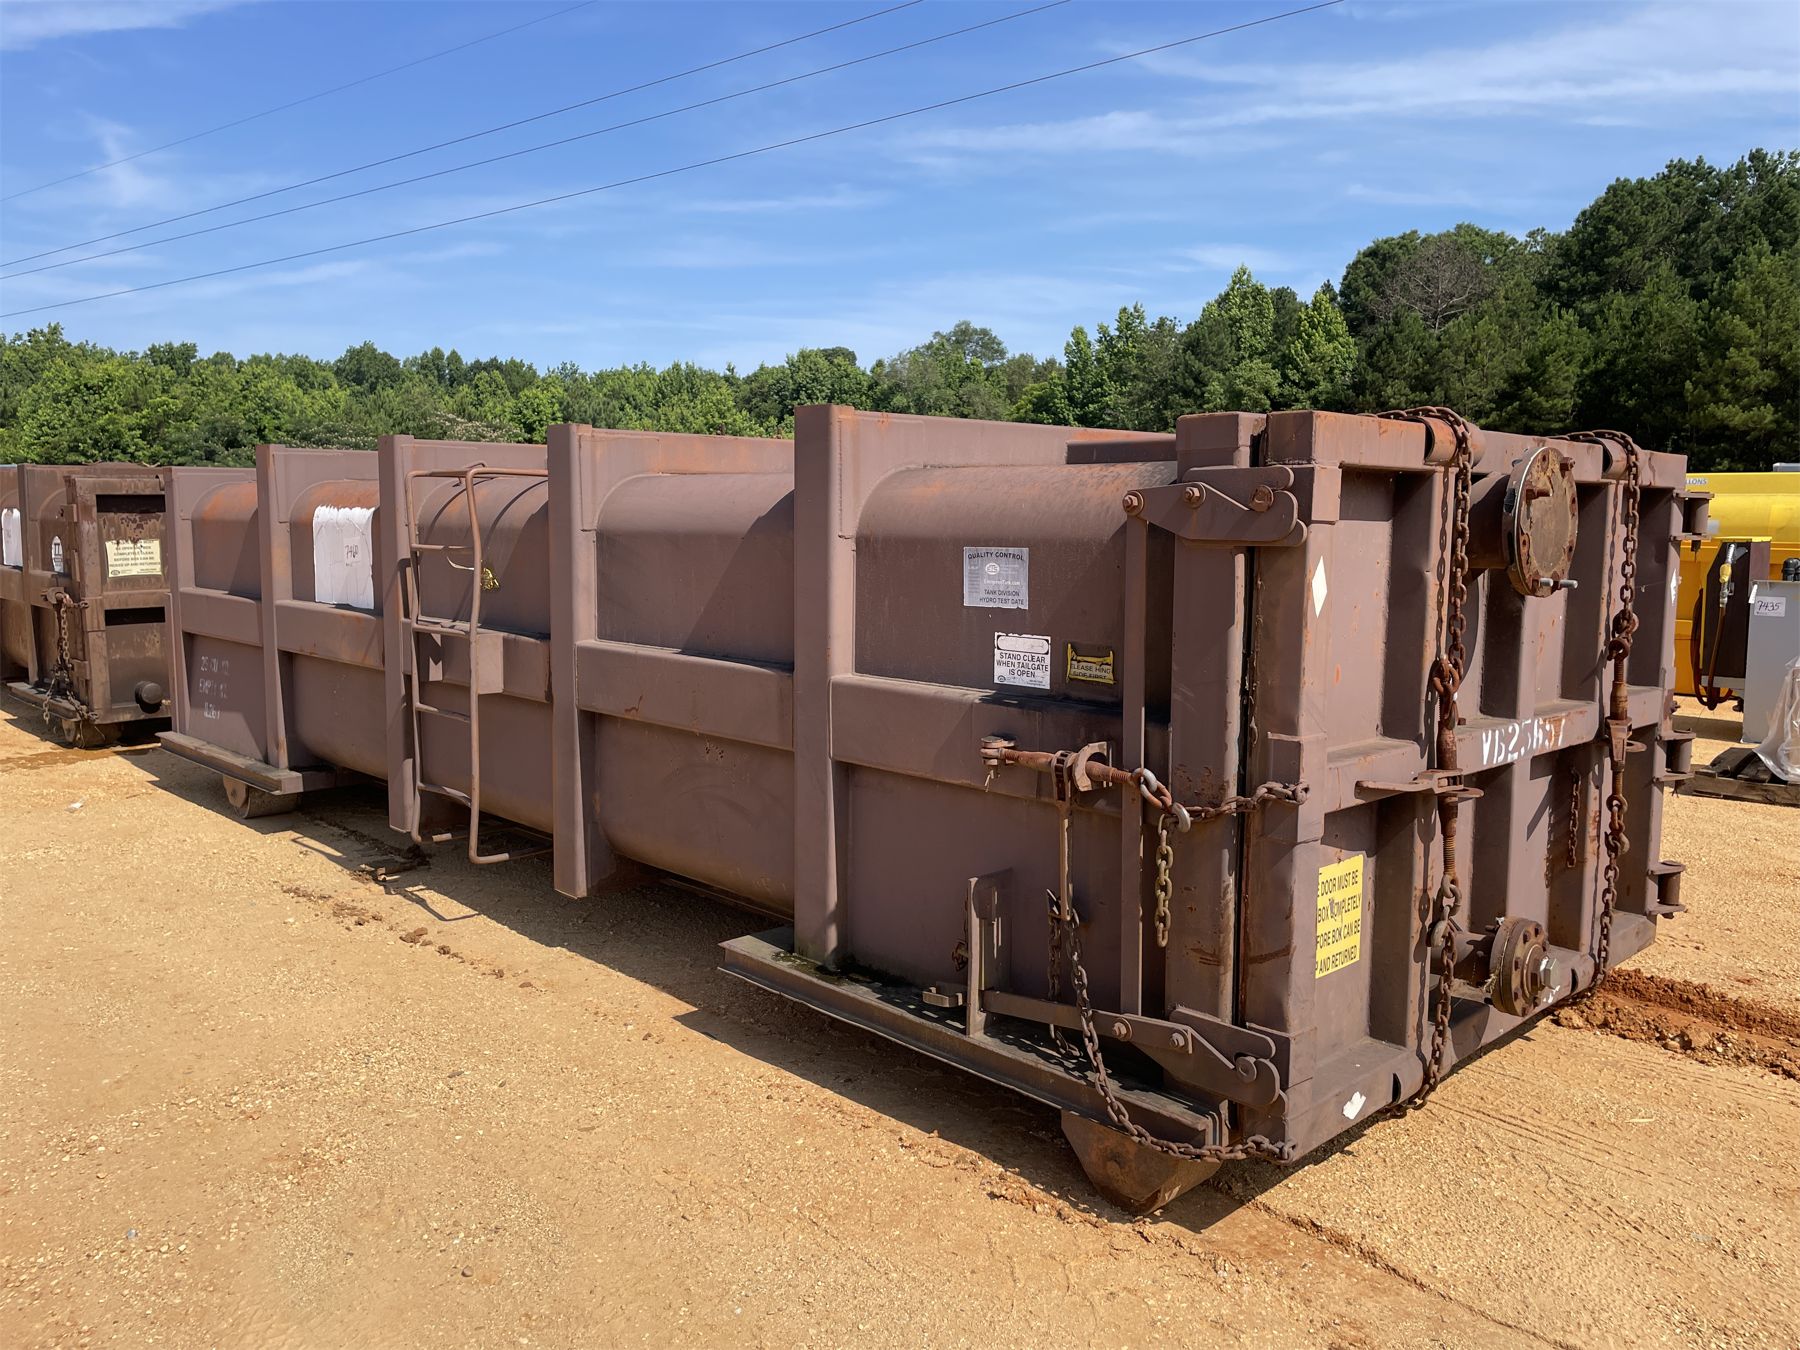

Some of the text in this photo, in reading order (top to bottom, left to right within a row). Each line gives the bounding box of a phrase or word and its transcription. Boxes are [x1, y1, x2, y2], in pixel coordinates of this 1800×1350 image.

[968, 551, 1024, 561] QUALITY CONTROL
[1757, 600, 1781, 612] 7435
[1000, 652, 1046, 663] STAND CLEAR
[996, 659, 1049, 672] WHEN TAILGATE
[1017, 669, 1036, 678] OPEN
[1320, 876, 1336, 897] DOOR
[1337, 872, 1351, 890] MUST
[1352, 869, 1359, 885] BE
[1318, 905, 1329, 923] BOX
[1343, 921, 1354, 940] CAN
[1354, 919, 1361, 934] BE
[1319, 956, 1331, 975] AND
[1331, 944, 1358, 968] RETURNED
